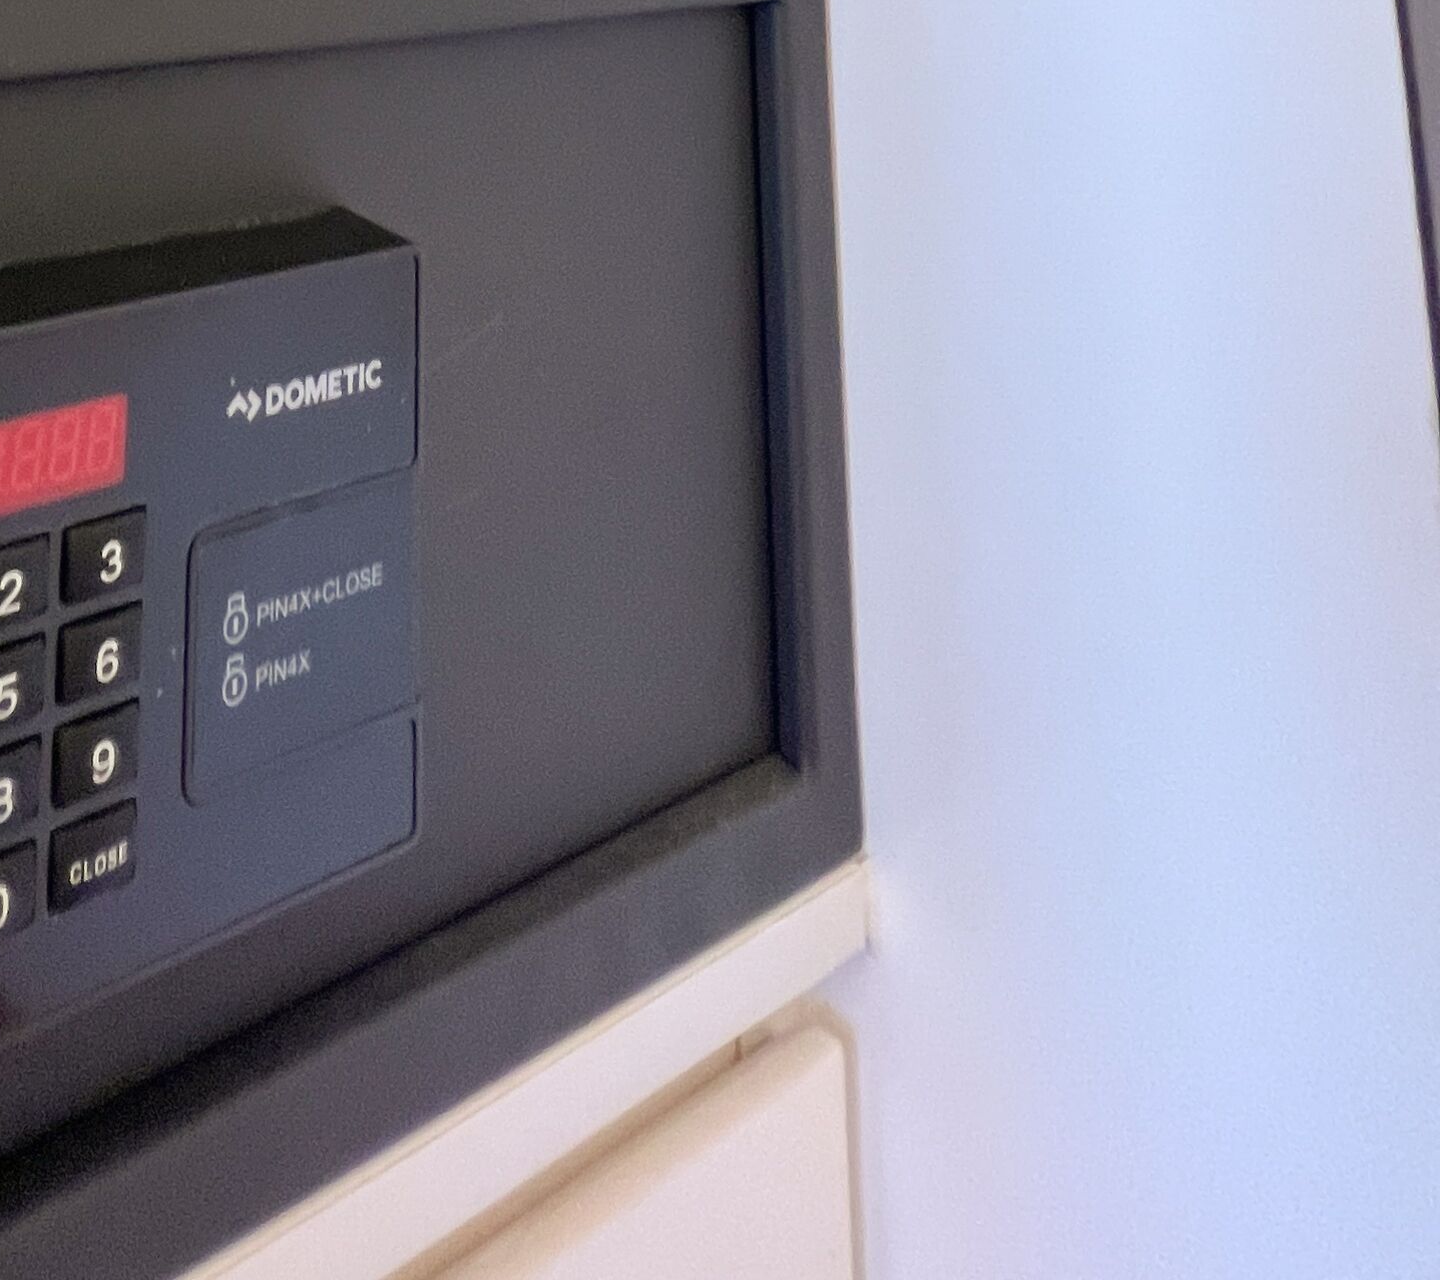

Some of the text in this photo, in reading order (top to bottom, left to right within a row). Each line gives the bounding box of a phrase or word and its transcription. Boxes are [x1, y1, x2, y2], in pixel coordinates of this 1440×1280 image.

[265, 359, 383, 417] DOMETIC
[100, 539, 123, 584] 3
[257, 561, 384, 628] PIN4X+CLOSE
[95, 637, 119, 684] 6
[255, 648, 310, 692] PIN4X
[92, 738, 116, 785] 9
[68, 840, 129, 886] CLOSE
